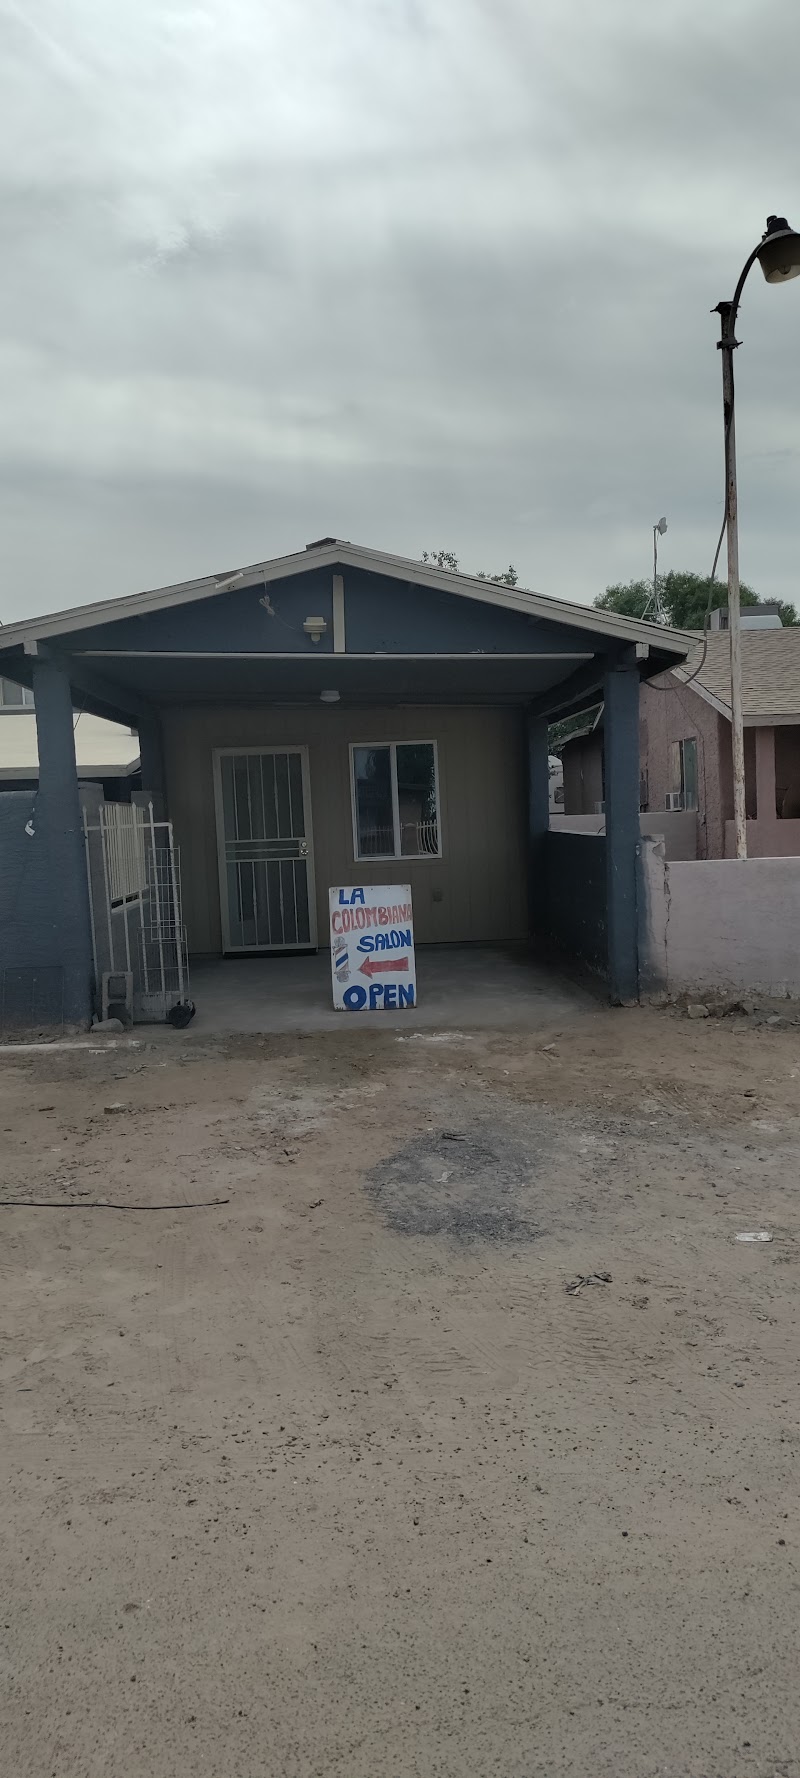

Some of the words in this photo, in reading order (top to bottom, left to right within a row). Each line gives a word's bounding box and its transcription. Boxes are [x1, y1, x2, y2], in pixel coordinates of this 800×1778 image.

[339, 888, 365, 904] LA
[332, 904, 413, 934] COLOMBIANA
[356, 929, 412, 953] SALON
[343, 984, 415, 1010] OPEN
